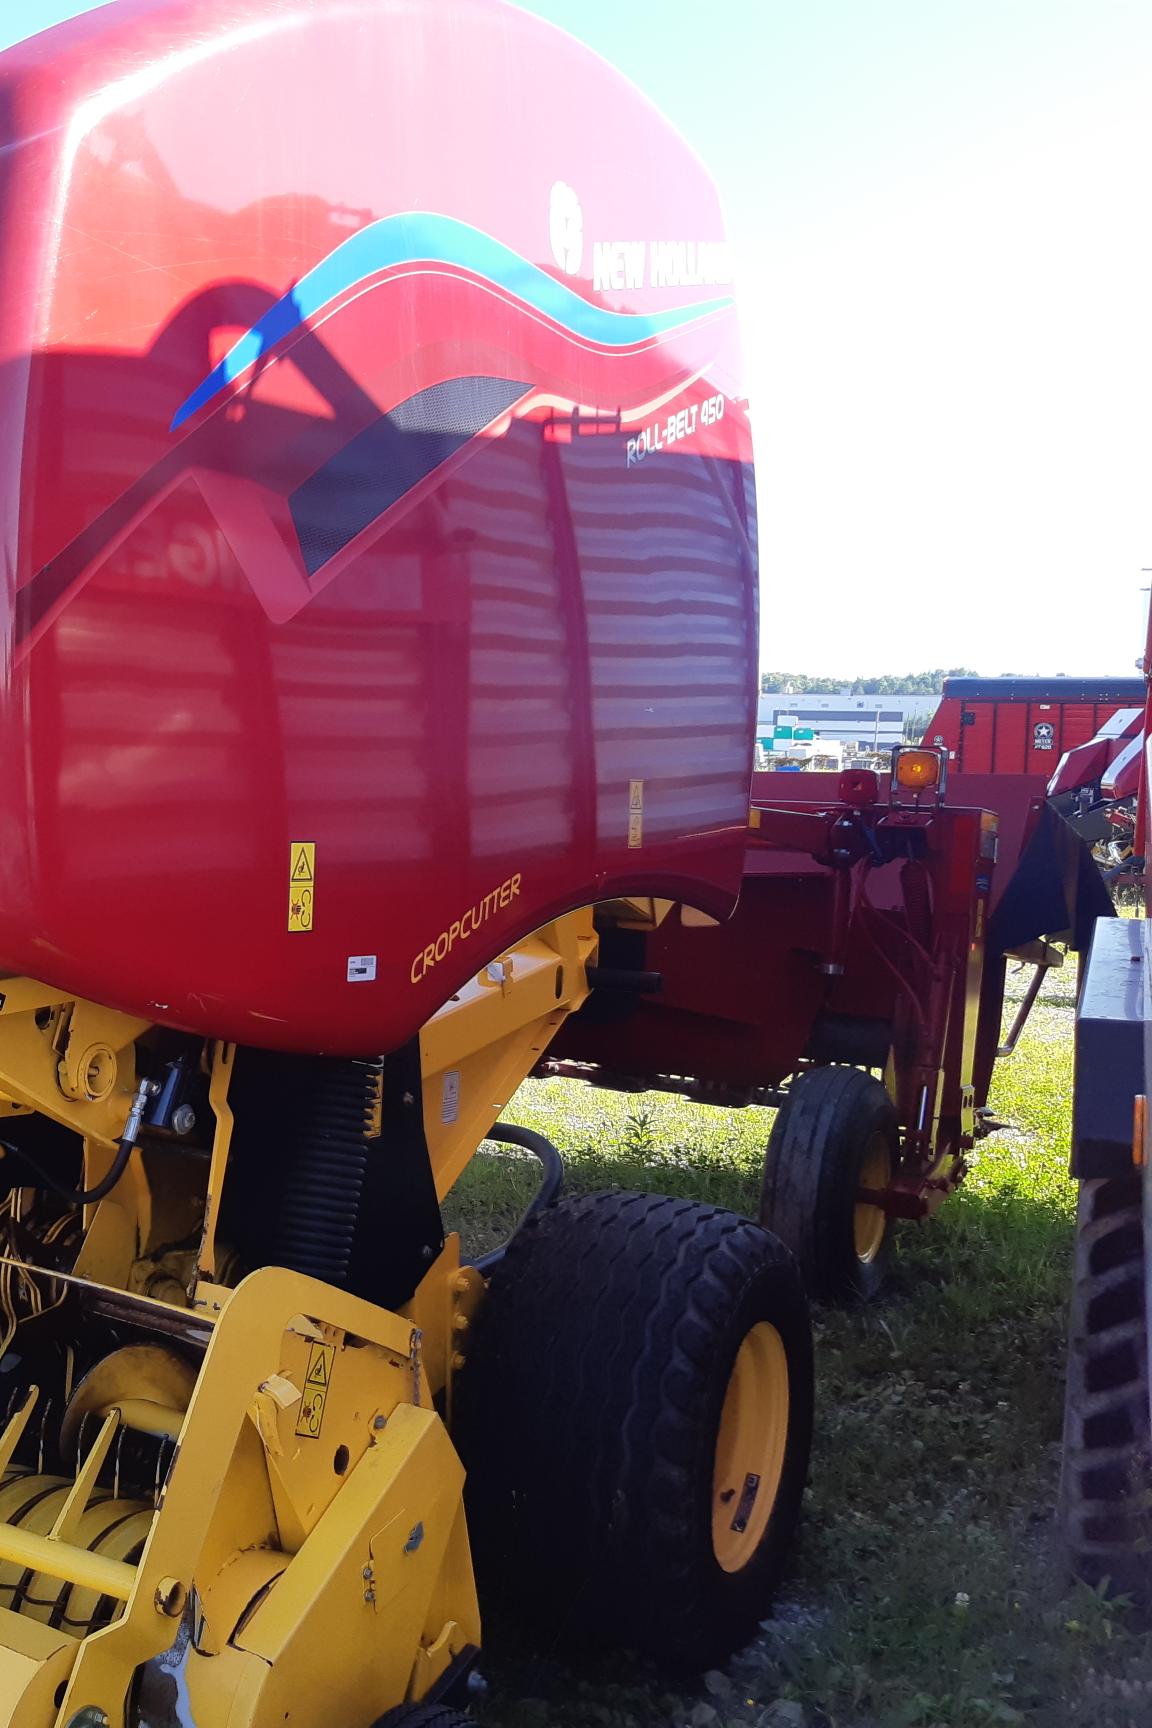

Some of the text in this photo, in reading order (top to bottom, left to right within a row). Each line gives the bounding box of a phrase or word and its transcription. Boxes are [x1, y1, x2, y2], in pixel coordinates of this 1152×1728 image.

[592, 240, 645, 292] NEW
[627, 394, 725, 468] ROLL-BELT 450
[410, 872, 521, 984] CROPCUTTER
